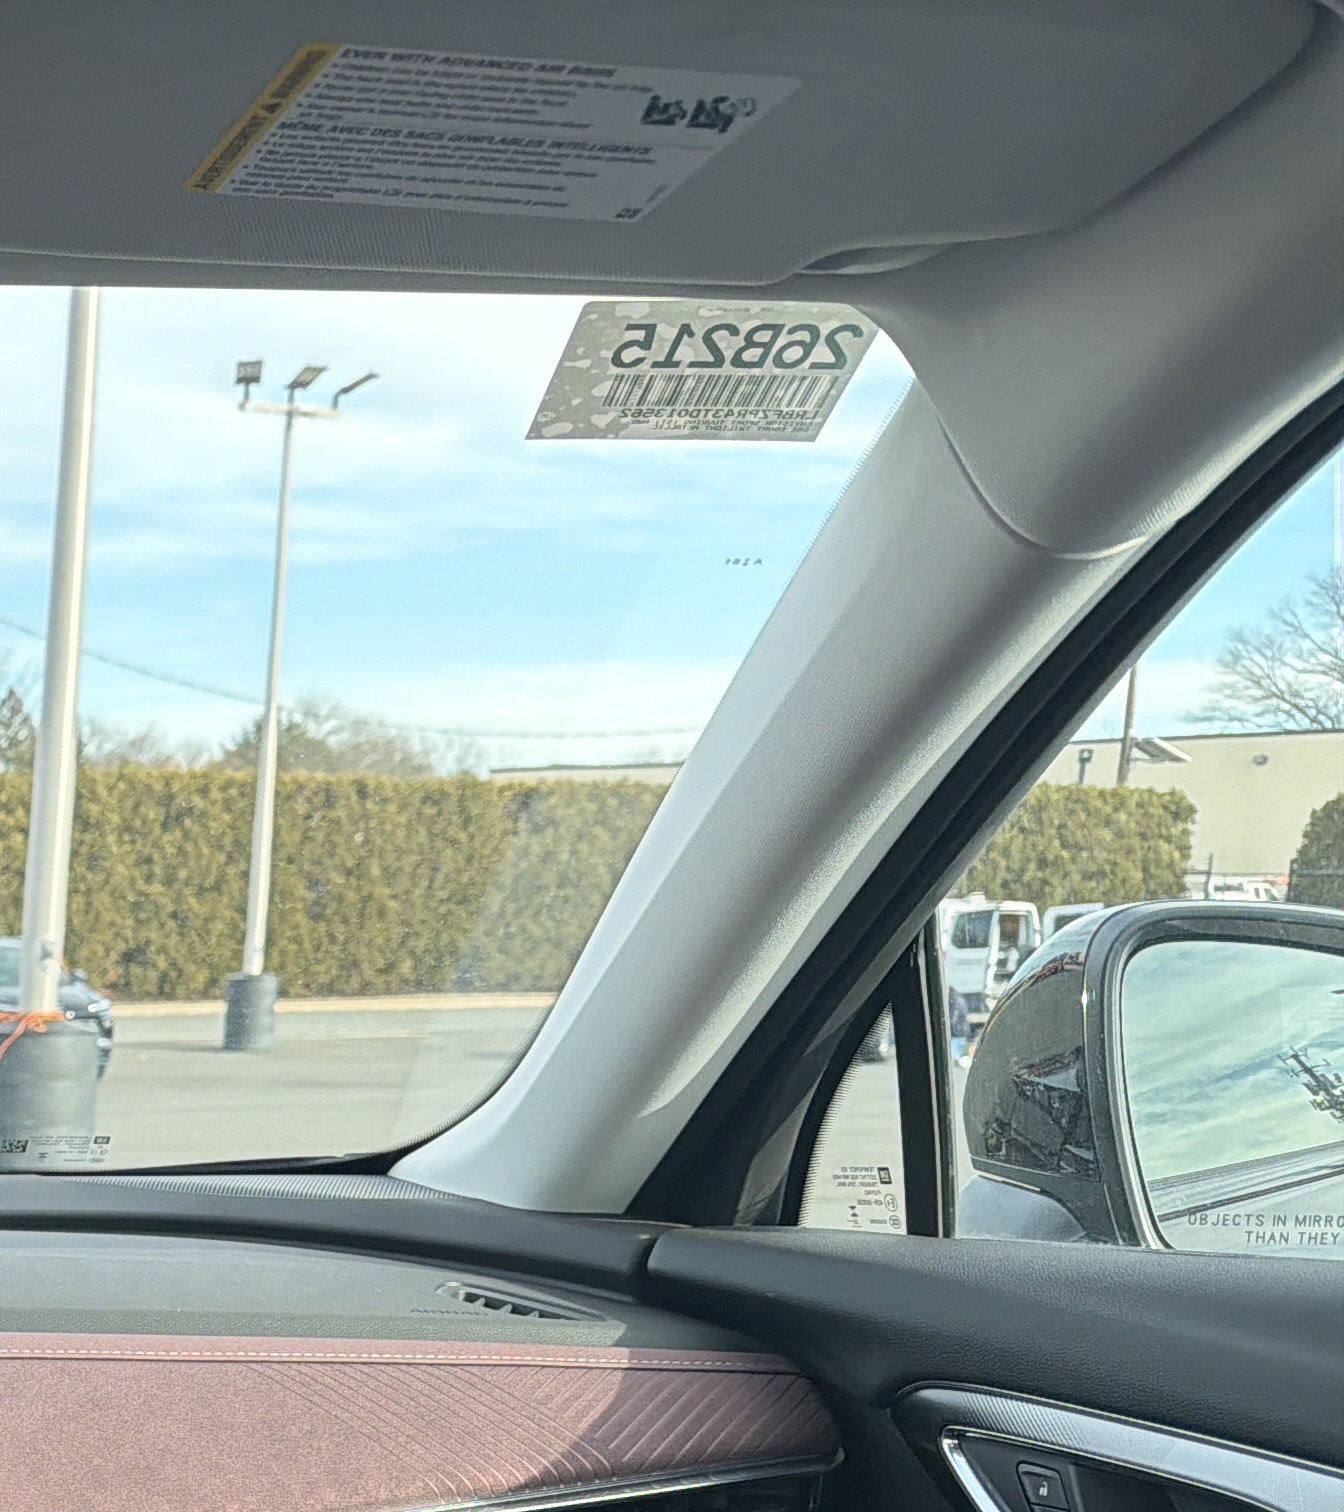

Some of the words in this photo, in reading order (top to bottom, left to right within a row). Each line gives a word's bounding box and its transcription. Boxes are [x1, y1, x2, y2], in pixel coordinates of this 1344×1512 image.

[1188, 1213, 1265, 1226] OBJECTS
[1272, 1214, 1287, 1227] IN
[1245, 1231, 1289, 1245] THAN
[1298, 1232, 1340, 1245] THEY
